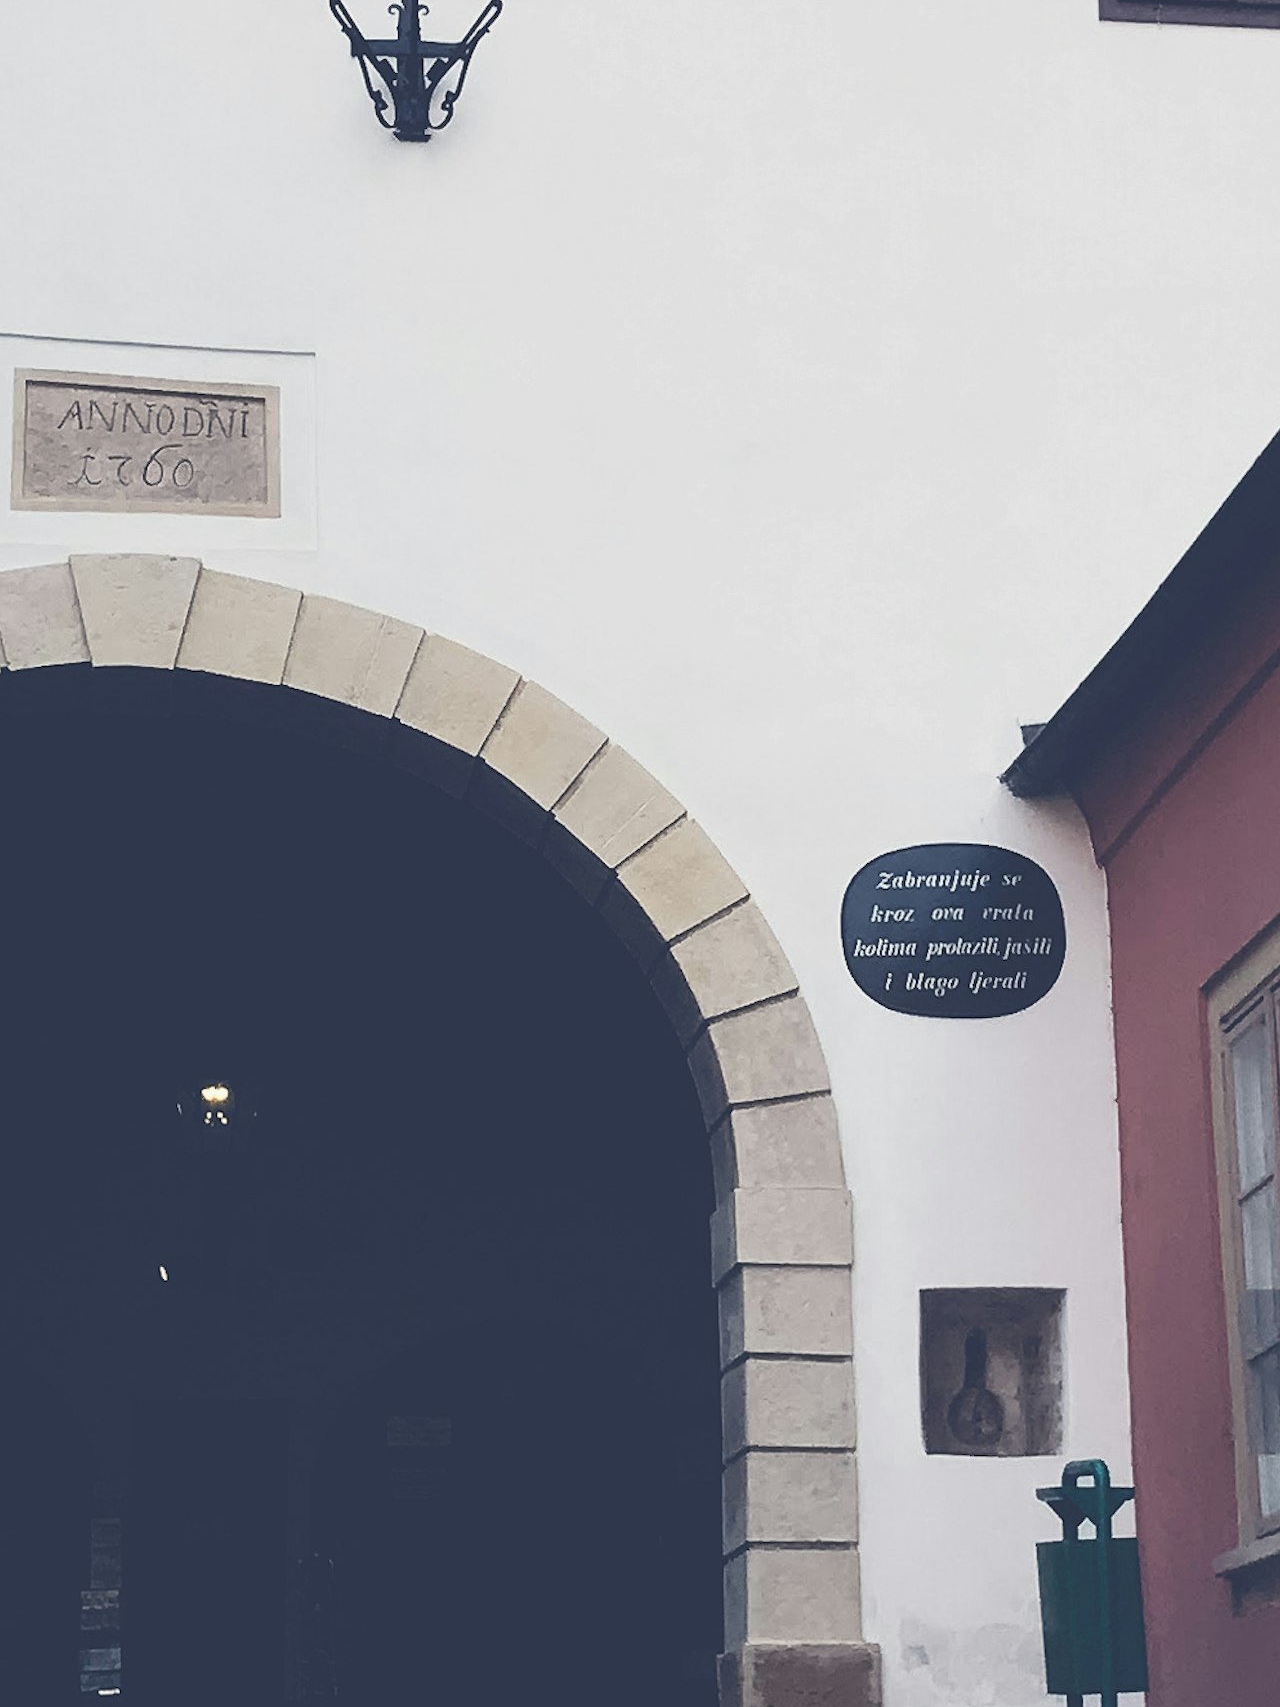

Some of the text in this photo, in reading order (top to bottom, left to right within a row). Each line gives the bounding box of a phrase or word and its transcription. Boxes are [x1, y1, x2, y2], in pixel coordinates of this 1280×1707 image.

[875, 869, 1023, 892] Zabranjuje se
[870, 904, 915, 923] kroz
[931, 906, 965, 922] ova
[853, 937, 917, 958] kolima
[884, 972, 893, 991] i
[905, 972, 960, 997] blago
